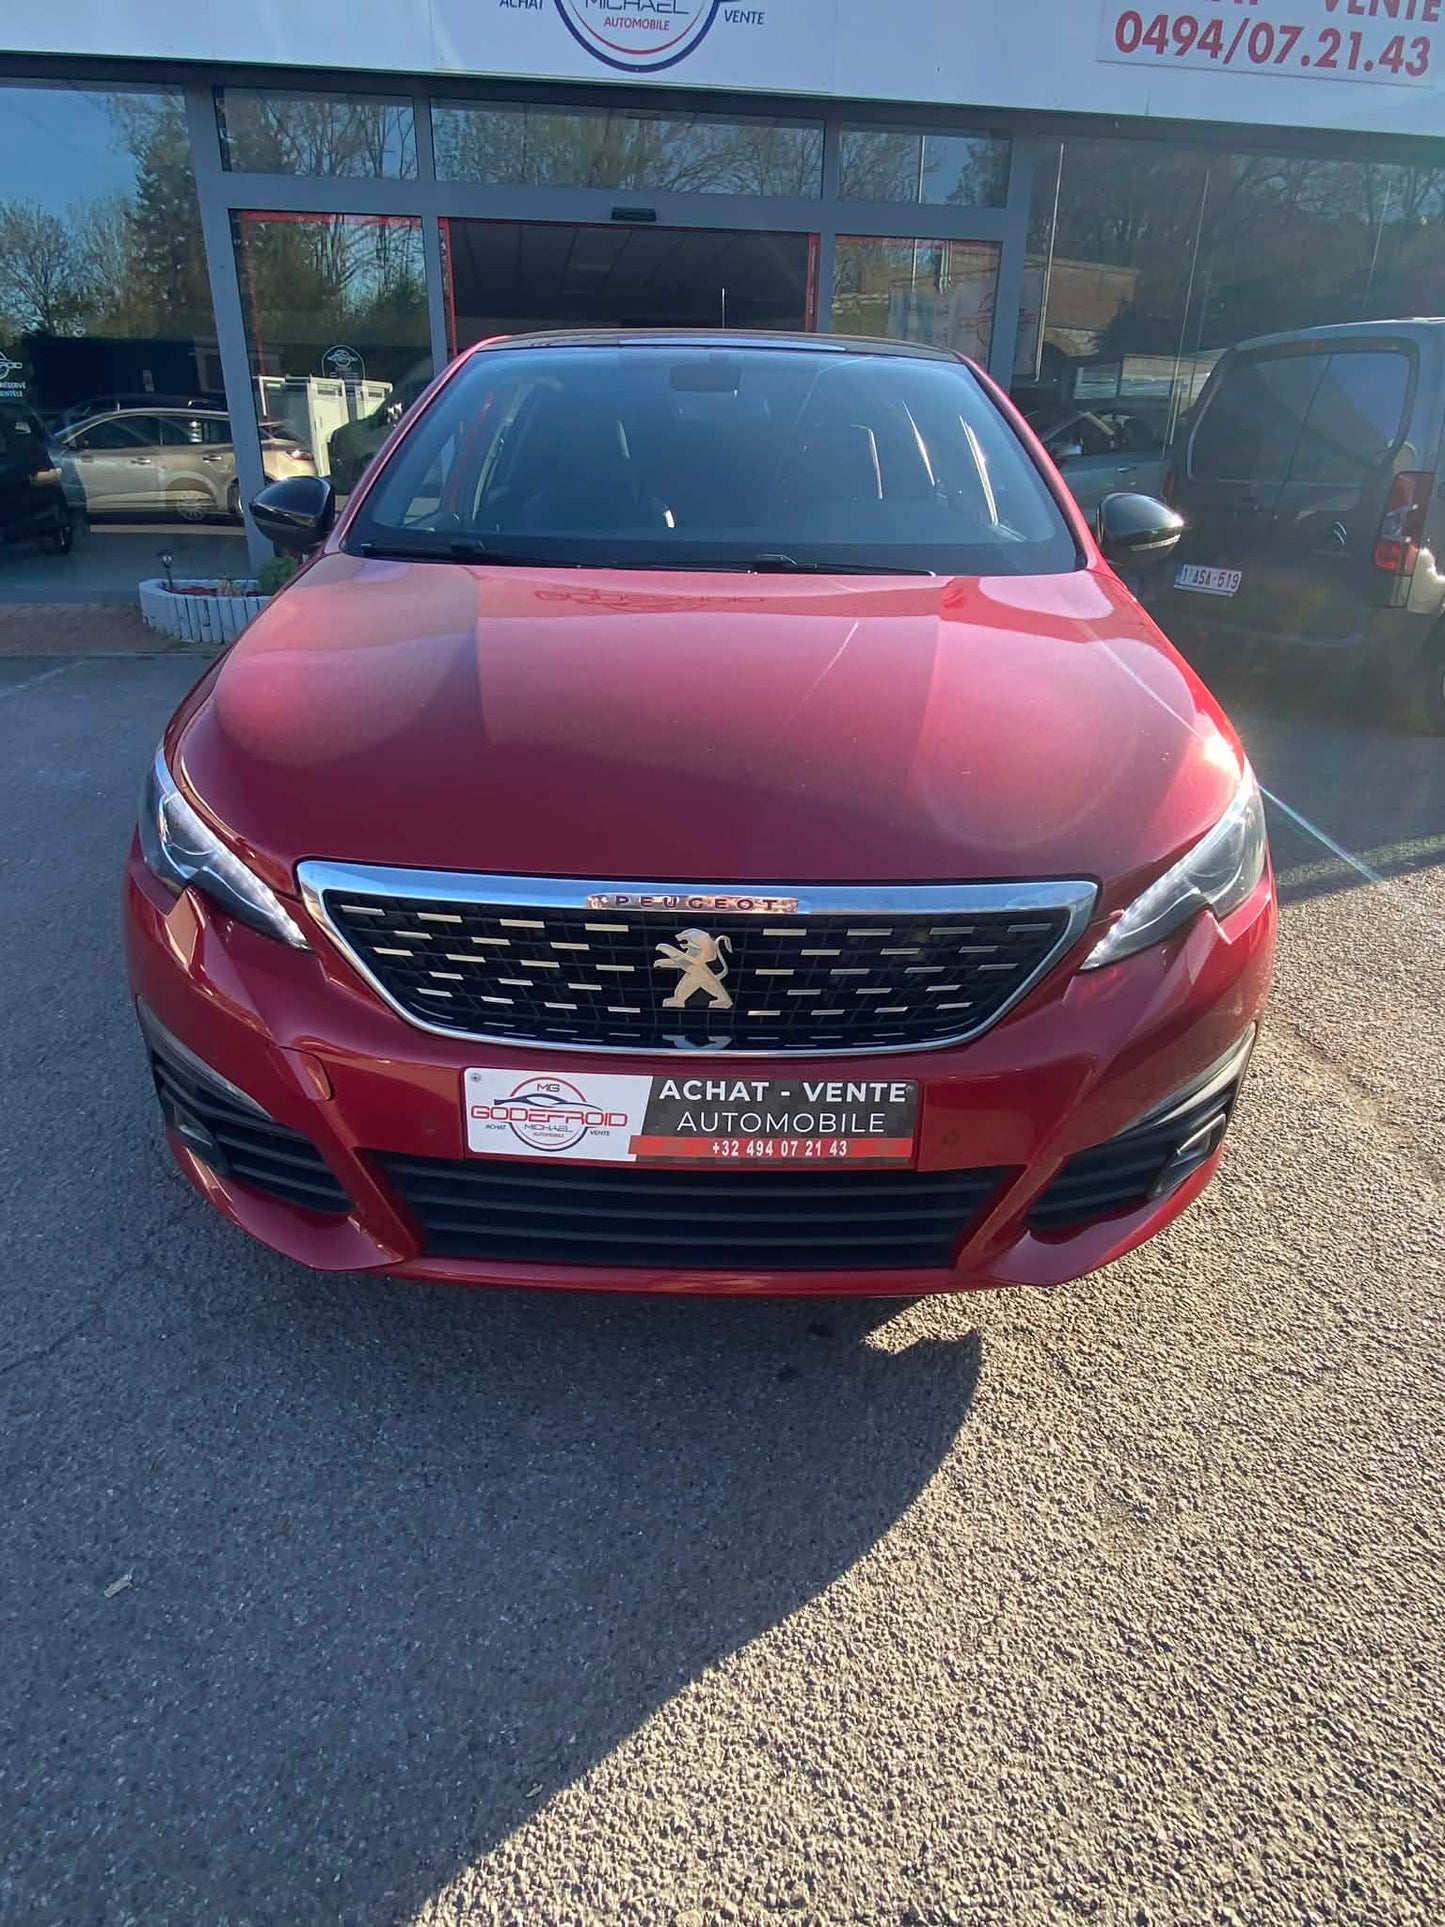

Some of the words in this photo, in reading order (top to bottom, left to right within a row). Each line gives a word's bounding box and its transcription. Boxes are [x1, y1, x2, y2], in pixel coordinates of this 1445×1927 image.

[604, 16, 670, 31] AUTOMOBILE
[724, 9, 765, 25] VENTE
[1115, 10, 1431, 77] 0494/07.21.43
[615, 895, 777, 911] PEUGEOT
[536, 1083, 560, 1093] MG
[656, 1079, 769, 1102] ACHAT
[802, 1082, 906, 1103] VENTE
[471, 1105, 628, 1127] GODEFROID
[676, 1111, 886, 1133] AUTOMOBILE
[524, 1123, 573, 1133] MICHAEL
[590, 1129, 610, 1137] VENTE
[713, 1140, 739, 1157] +32
[746, 1140, 774, 1157] 494
[780, 1140, 799, 1157] 07
[805, 1140, 822, 1157] 21
[829, 1140, 848, 1157] 43
